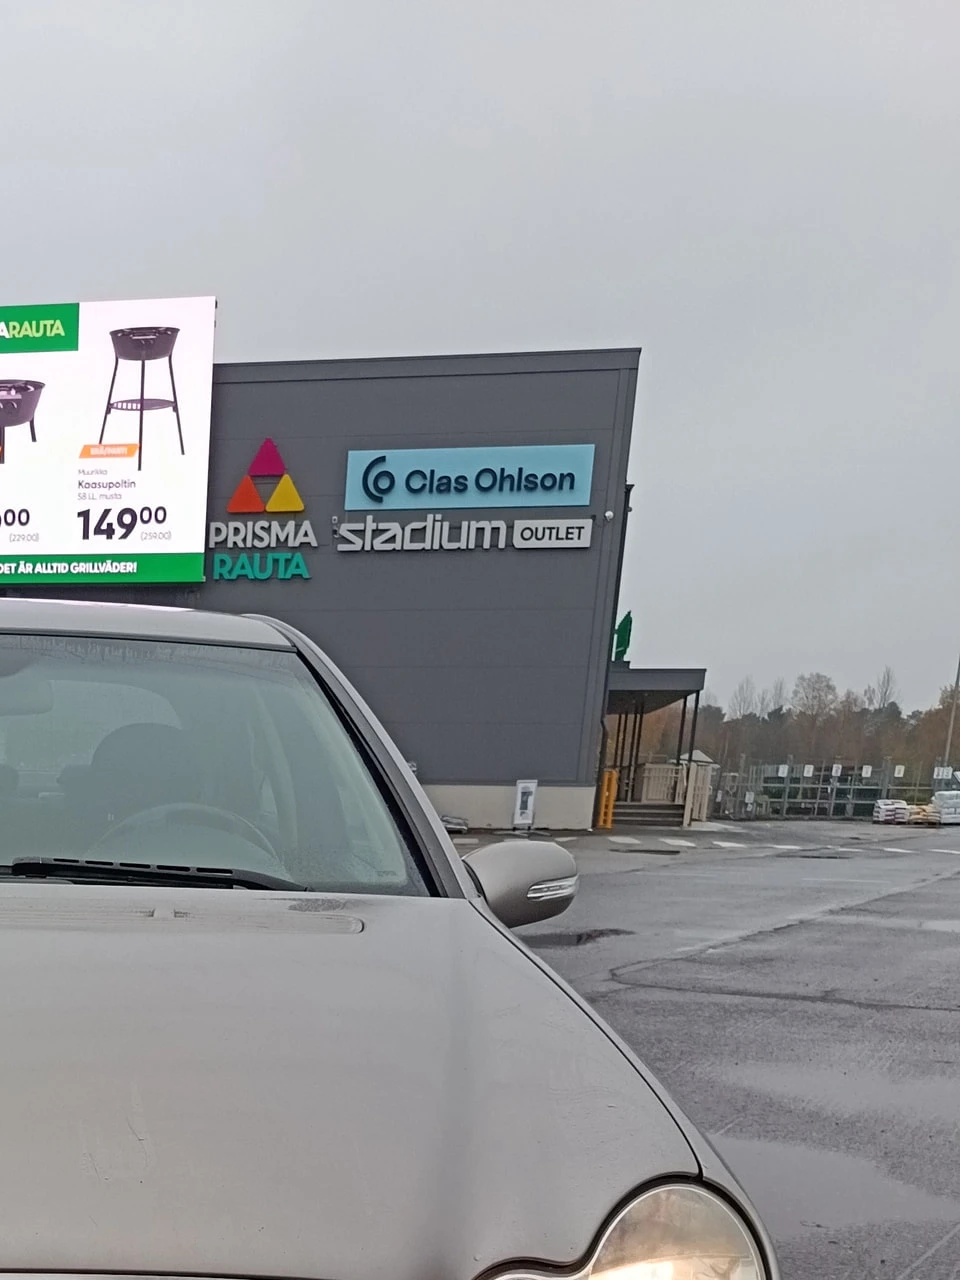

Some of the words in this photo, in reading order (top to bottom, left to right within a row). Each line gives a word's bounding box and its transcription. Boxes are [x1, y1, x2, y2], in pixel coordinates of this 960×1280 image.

[77, 479, 136, 491] Kaasupoltin
[405, 469, 468, 494] Clas
[474, 467, 575, 493] Ohlson
[208, 520, 318, 548] PRISMA
[337, 514, 507, 551] stadium
[520, 526, 585, 542] OUTLET
[34, 561, 69, 574] ALLTID
[70, 559, 138, 573] GRILLVÄDER!
[213, 552, 311, 580] RAUTA
